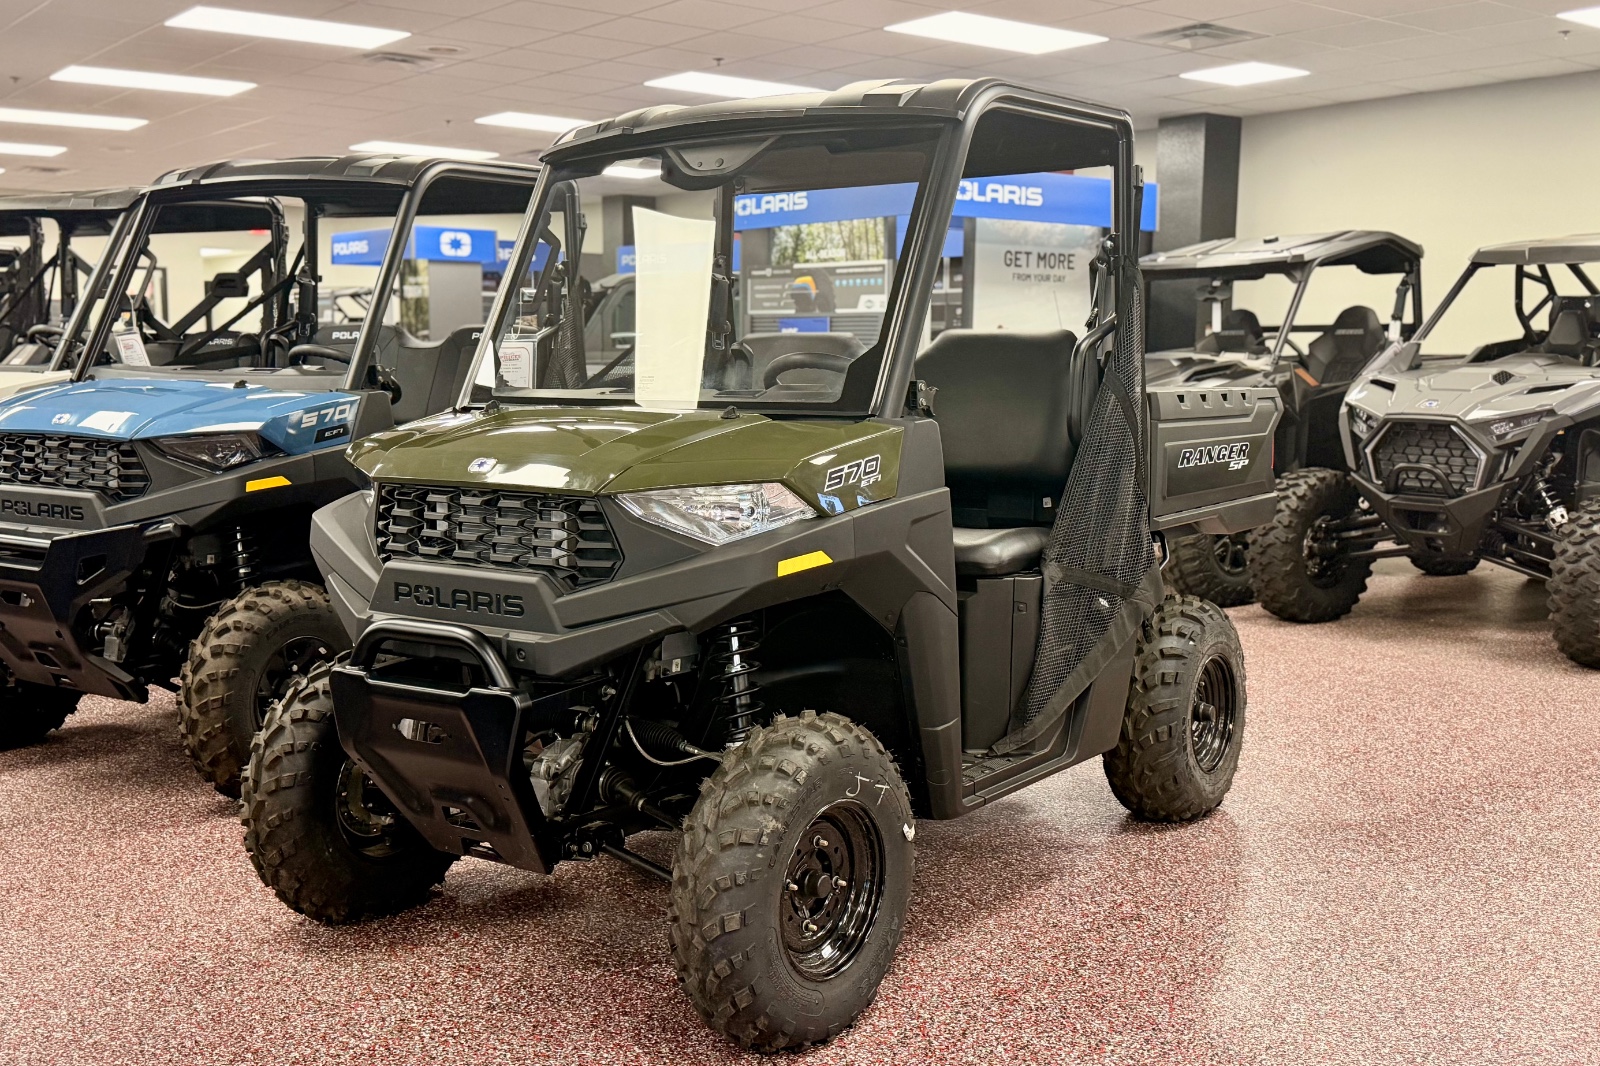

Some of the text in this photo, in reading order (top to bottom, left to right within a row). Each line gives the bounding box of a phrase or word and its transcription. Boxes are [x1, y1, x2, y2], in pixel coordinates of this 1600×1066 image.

[956, 181, 1043, 206] OLARIS
[734, 192, 808, 216] OLARIS
[333, 241, 369, 256] POLARIS
[1003, 250, 1076, 270] GET MORE
[1012, 272, 1067, 283] FROM YOUR DAY
[332, 331, 360, 340] POLA
[301, 404, 351, 428] 570
[324, 428, 344, 437] EFI
[1178, 442, 1250, 468] RANGER
[1228, 459, 1249, 471] SP
[824, 454, 881, 492] 570
[861, 474, 881, 487] EFI
[2, 500, 84, 520] POLARIS
[394, 582, 525, 618] POLARIS
